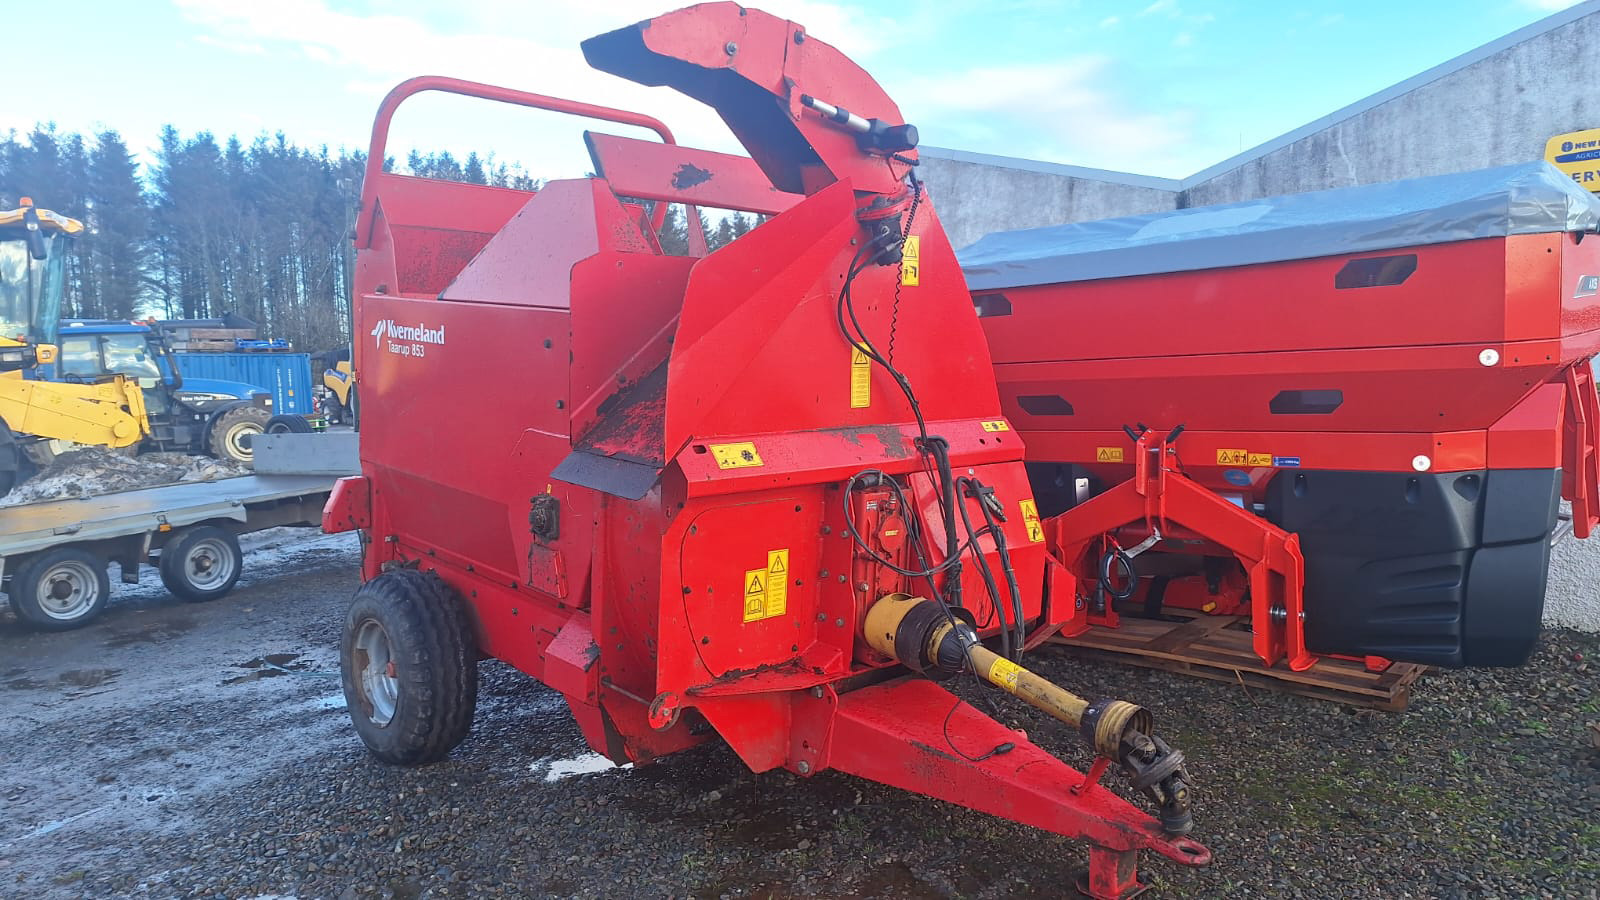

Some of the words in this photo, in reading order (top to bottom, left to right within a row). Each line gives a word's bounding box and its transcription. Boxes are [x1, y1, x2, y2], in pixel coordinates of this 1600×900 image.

[1575, 140, 1597, 149] NEW
[1575, 150, 1600, 159] AGRIC
[387, 319, 445, 345] Kverneland
[387, 340, 410, 357] Taarup
[411, 343, 425, 358] 853
